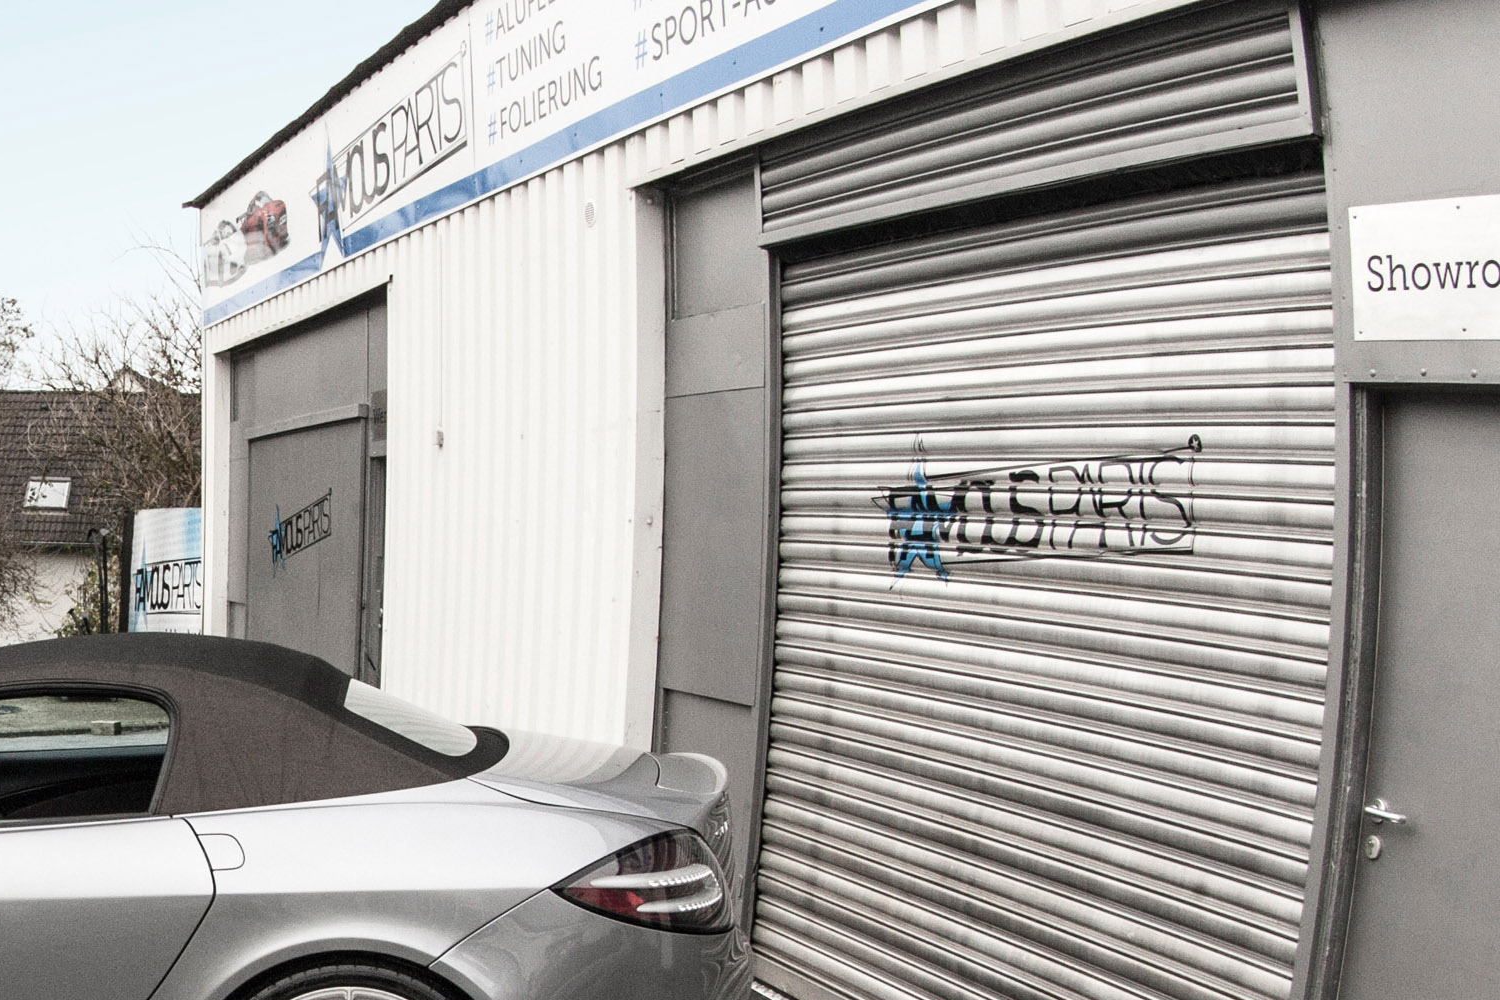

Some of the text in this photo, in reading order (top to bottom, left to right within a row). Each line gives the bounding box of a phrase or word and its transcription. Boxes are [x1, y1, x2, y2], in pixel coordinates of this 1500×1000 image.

[485, 20, 567, 97] #TUNING
[390, 61, 463, 185] PARTS
[487, 55, 603, 145] #FOLIERUNG
[1366, 254, 1500, 293] Showro
[303, 497, 330, 546] PARTS
